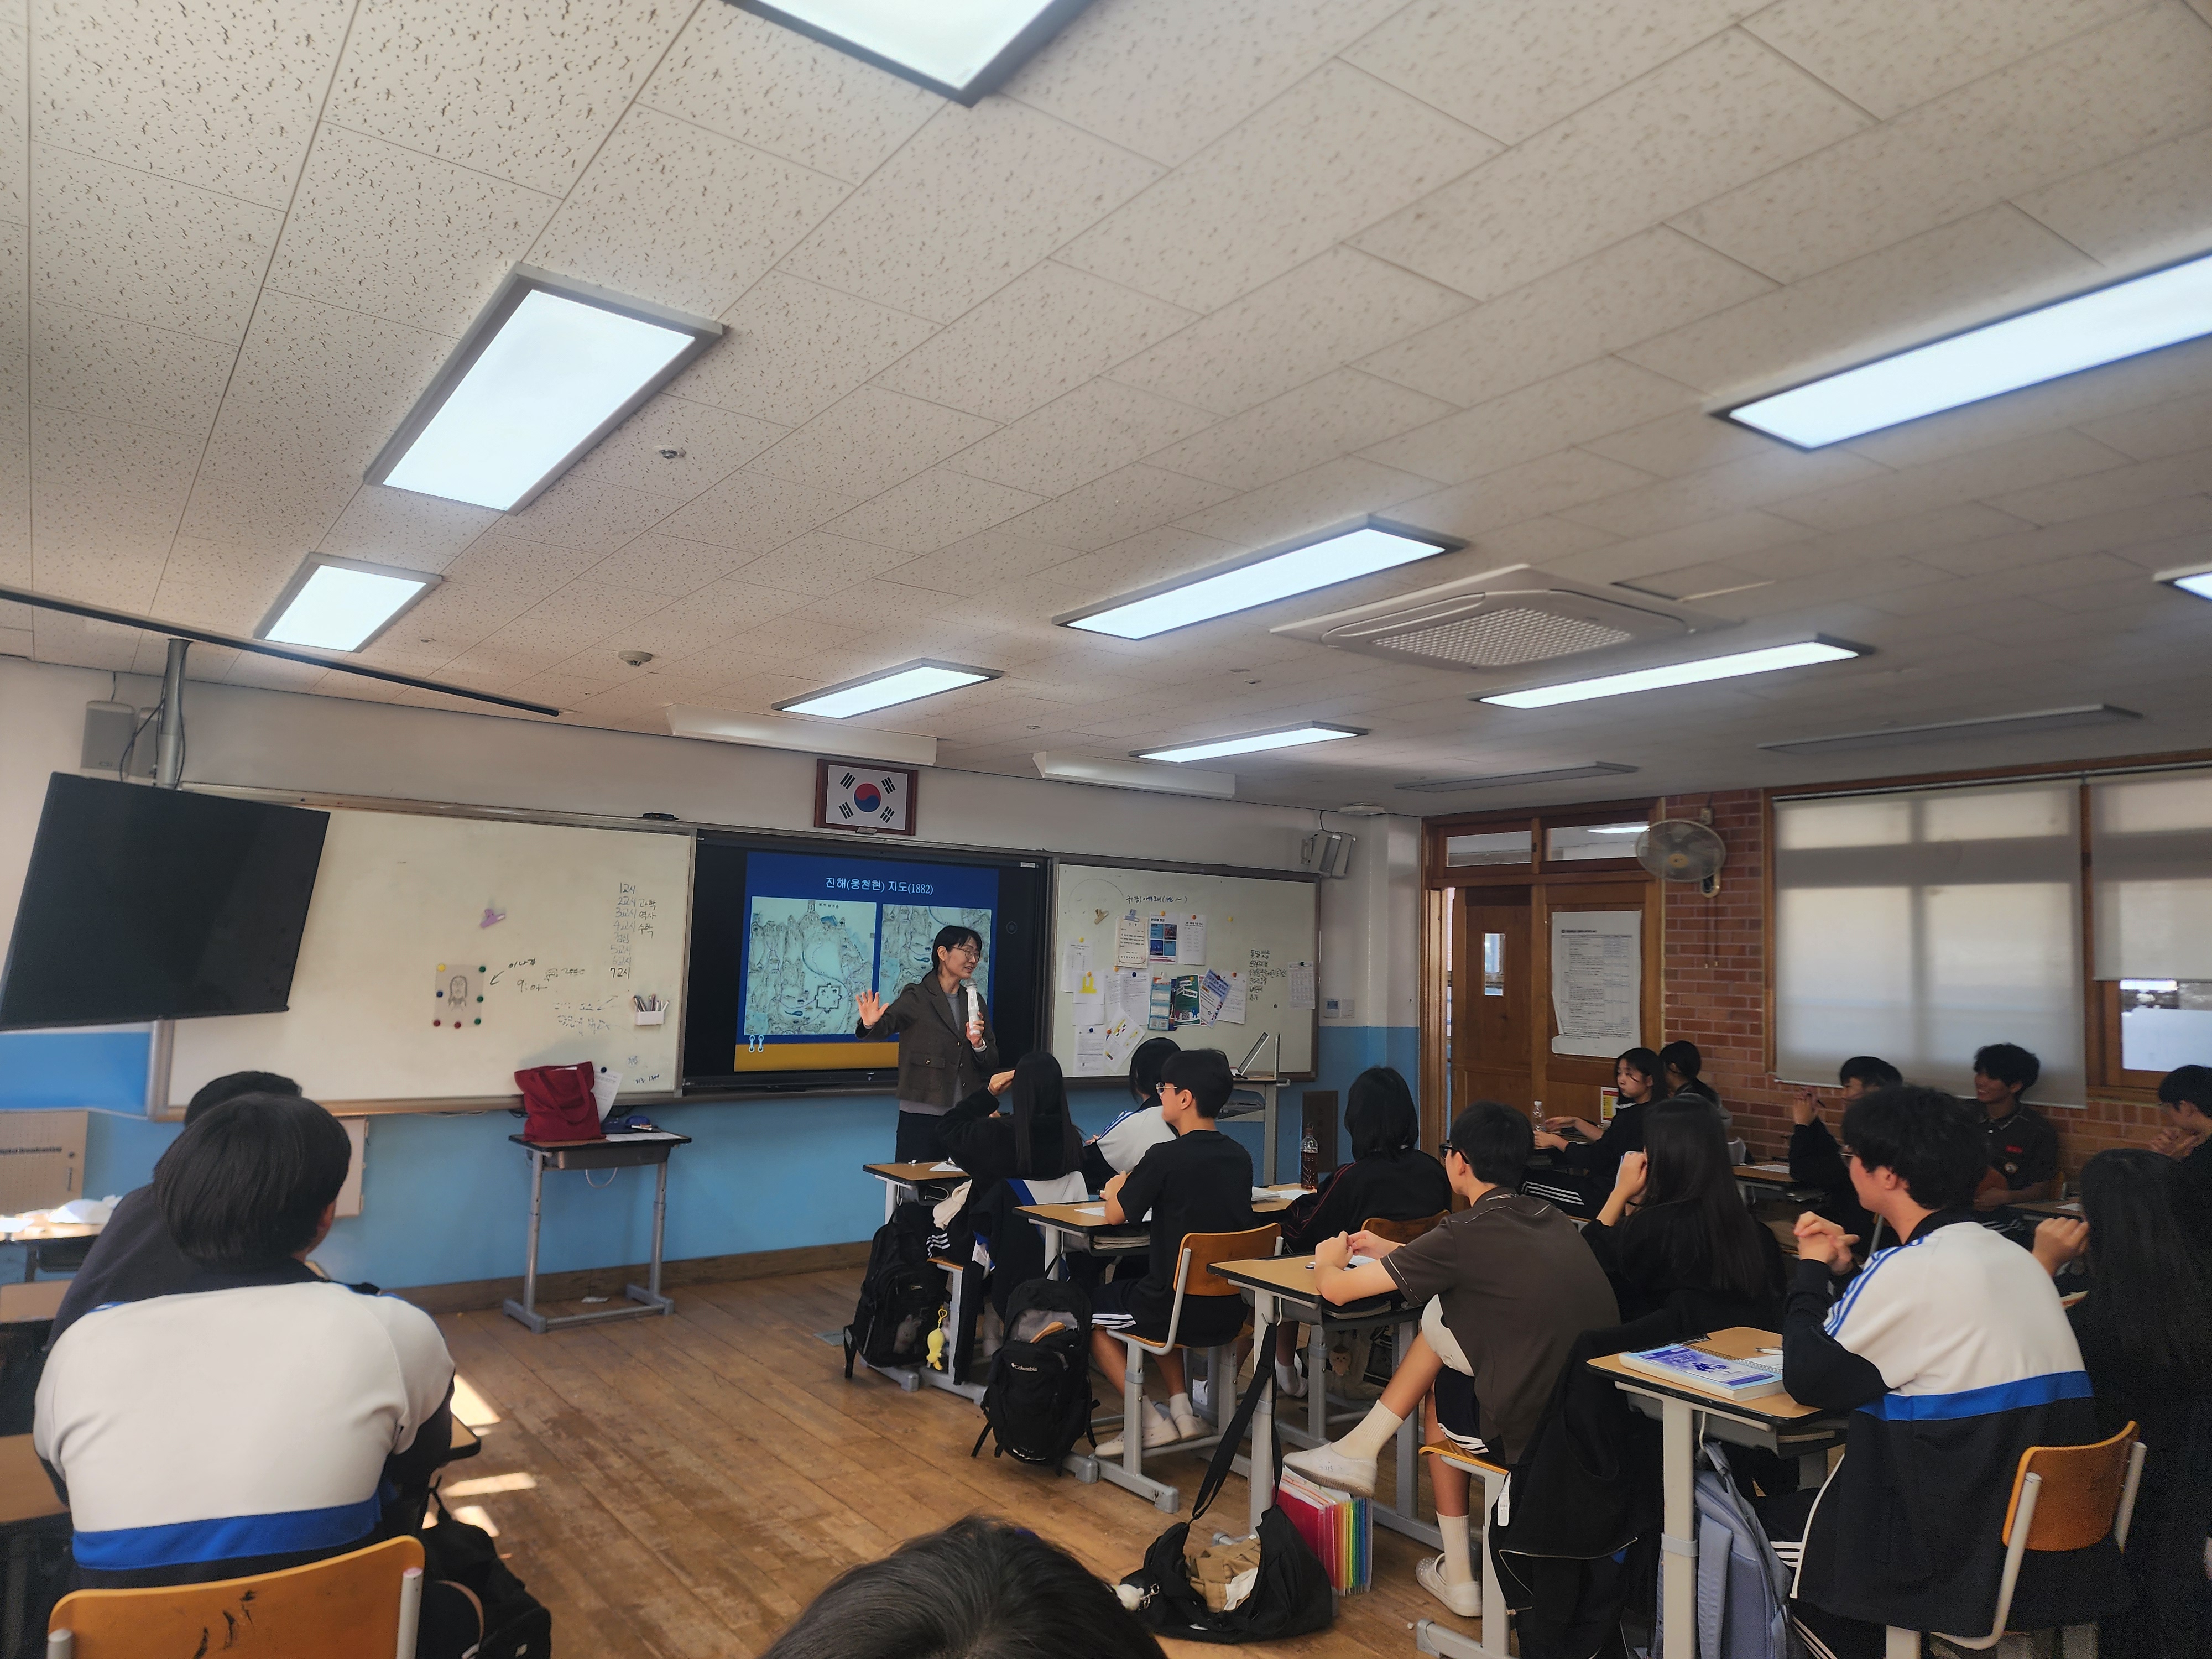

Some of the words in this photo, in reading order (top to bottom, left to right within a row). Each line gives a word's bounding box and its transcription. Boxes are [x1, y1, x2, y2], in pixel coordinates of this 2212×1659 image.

[826, 877, 885, 893] 진해(웅천현)
[888, 881, 933, 895] 지도(1882)
[610, 967, 630, 979] 7교시
